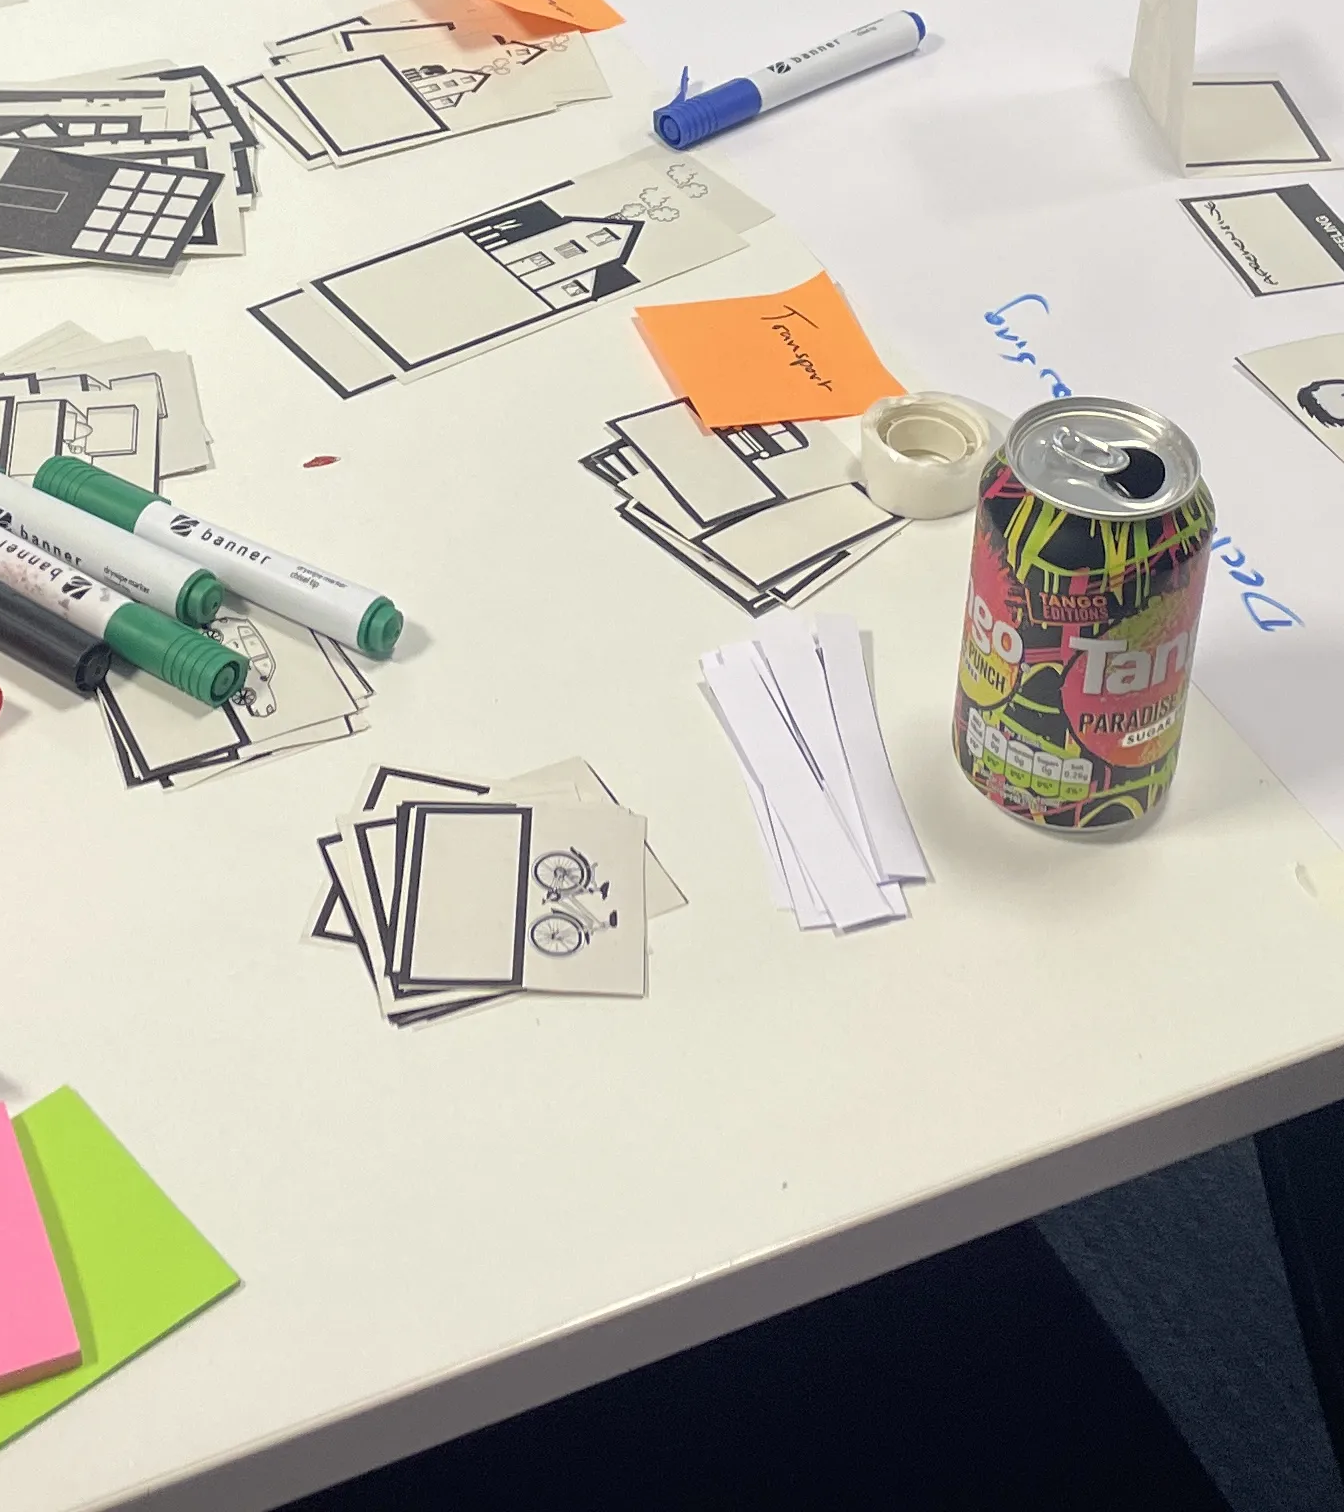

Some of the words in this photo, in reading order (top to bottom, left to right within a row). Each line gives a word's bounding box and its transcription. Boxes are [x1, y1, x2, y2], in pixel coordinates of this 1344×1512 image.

[791, 38, 841, 64] banner
[760, 305, 832, 392] Transport
[201, 528, 271, 565] banner
[1040, 592, 1107, 609] TANGO
[1043, 606, 1109, 621] EDITIONS
[968, 640, 1006, 693] PUNCH
[1069, 630, 1194, 695] Tan
